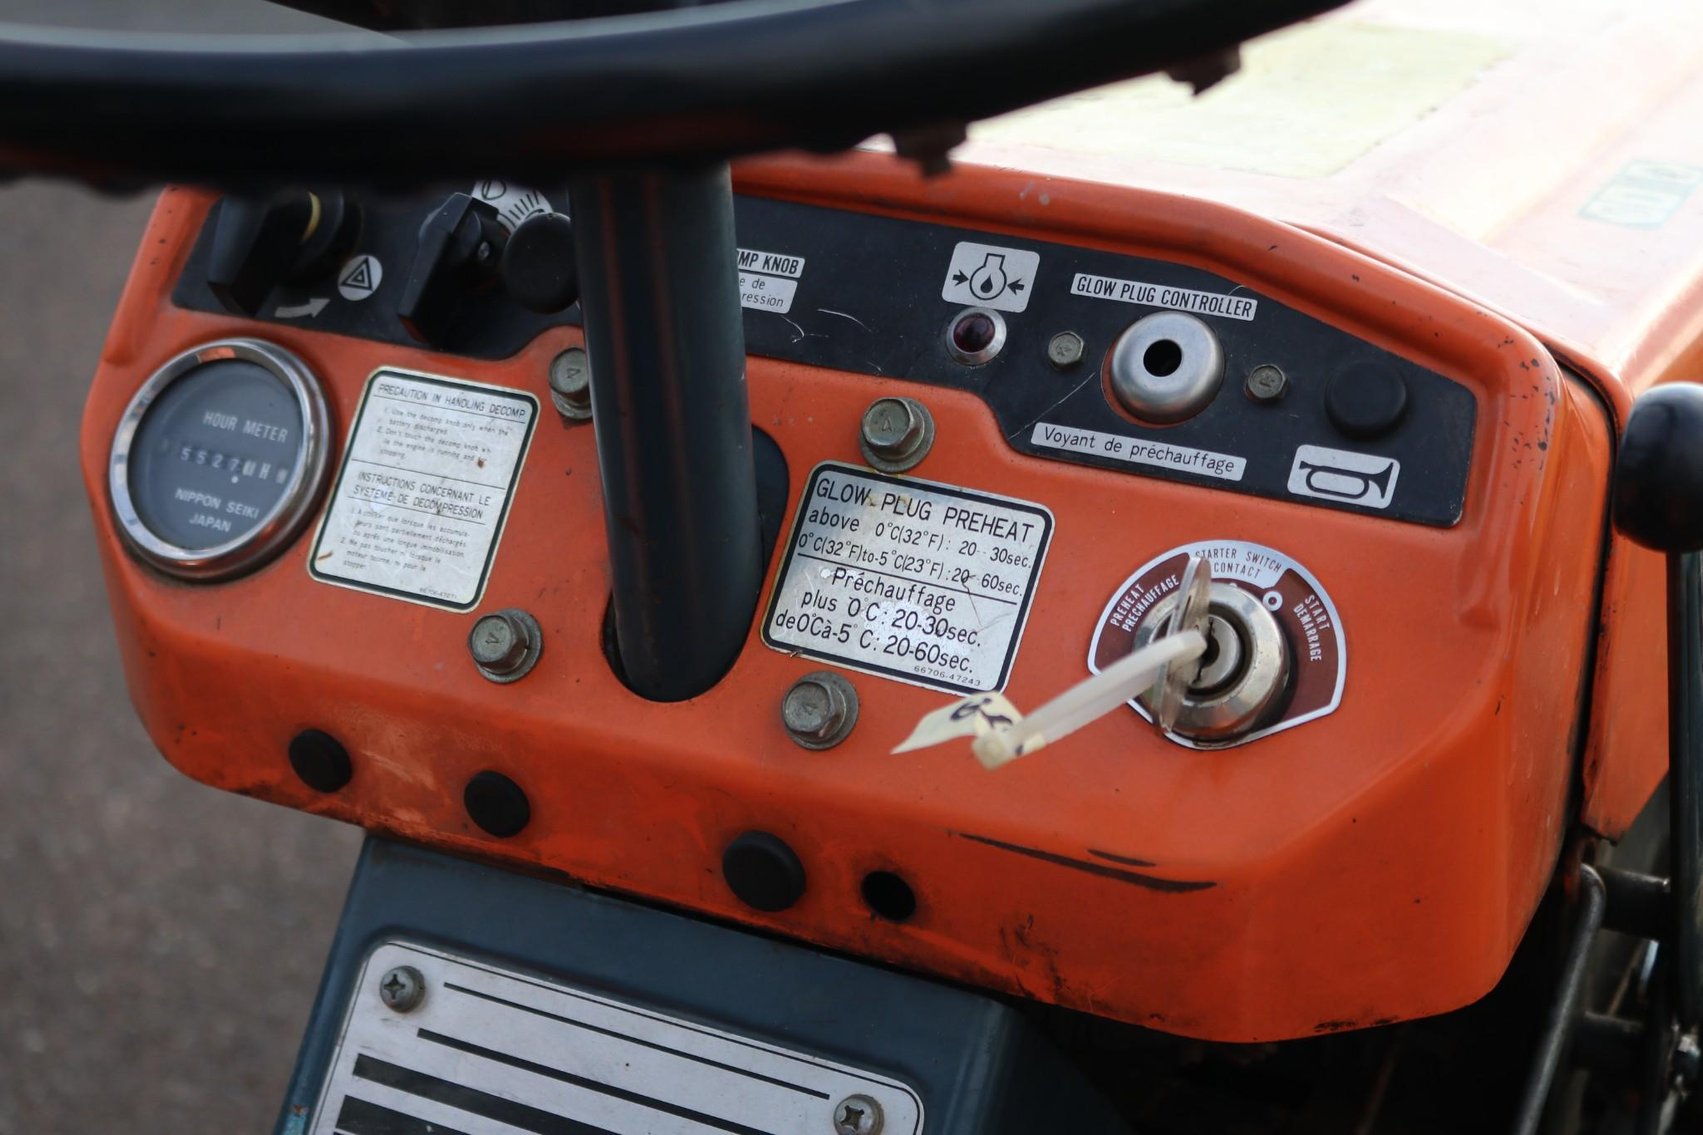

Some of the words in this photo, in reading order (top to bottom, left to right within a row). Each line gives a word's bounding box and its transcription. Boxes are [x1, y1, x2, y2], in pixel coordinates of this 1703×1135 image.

[738, 250, 760, 269] MP
[761, 254, 800, 275] KNOB
[741, 292, 785, 308] ression
[751, 278, 767, 290] de
[1076, 275, 1118, 298] GLOW
[1120, 282, 1157, 304] PLUG
[1160, 288, 1254, 319] CONTROLLER
[378, 383, 428, 400] PRECAUTION
[431, 393, 441, 402] IN
[444, 395, 485, 410] HANDLING
[489, 403, 525, 418] DECOMP
[202, 411, 239, 433] HOUR
[242, 420, 289, 444] METER
[1044, 426, 1096, 449] Voyant
[1103, 437, 1123, 453] de
[1129, 444, 1236, 475] préchauffage
[174, 487, 222, 509] NIPPON
[226, 501, 260, 519] SEIKI
[357, 471, 415, 490] INSTRUCTIONS
[419, 483, 474, 502] CONCERNANT
[478, 494, 491, 505] LE
[397, 493, 409, 504] DE
[412, 496, 483, 519] DECOMPRESSION
[809, 507, 860, 532] above
[816, 478, 871, 506] GLOW
[880, 493, 932, 521] PLUG
[943, 507, 1034, 543] PREHEAT
[188, 513, 232, 533] JAPAN
[1195, 548, 1237, 559] STARTER
[1245, 551, 1282, 572] SWITCH
[1213, 562, 1261, 579] CONTACT
[801, 589, 838, 612] plus
[832, 567, 956, 615] Préchauffage
[1110, 583, 1144, 627] PREHEAT
[1121, 574, 1180, 632] PRECHAUFFAGE
[1304, 594, 1330, 630] START
[1293, 603, 1322, 662] DEMARRAGE
